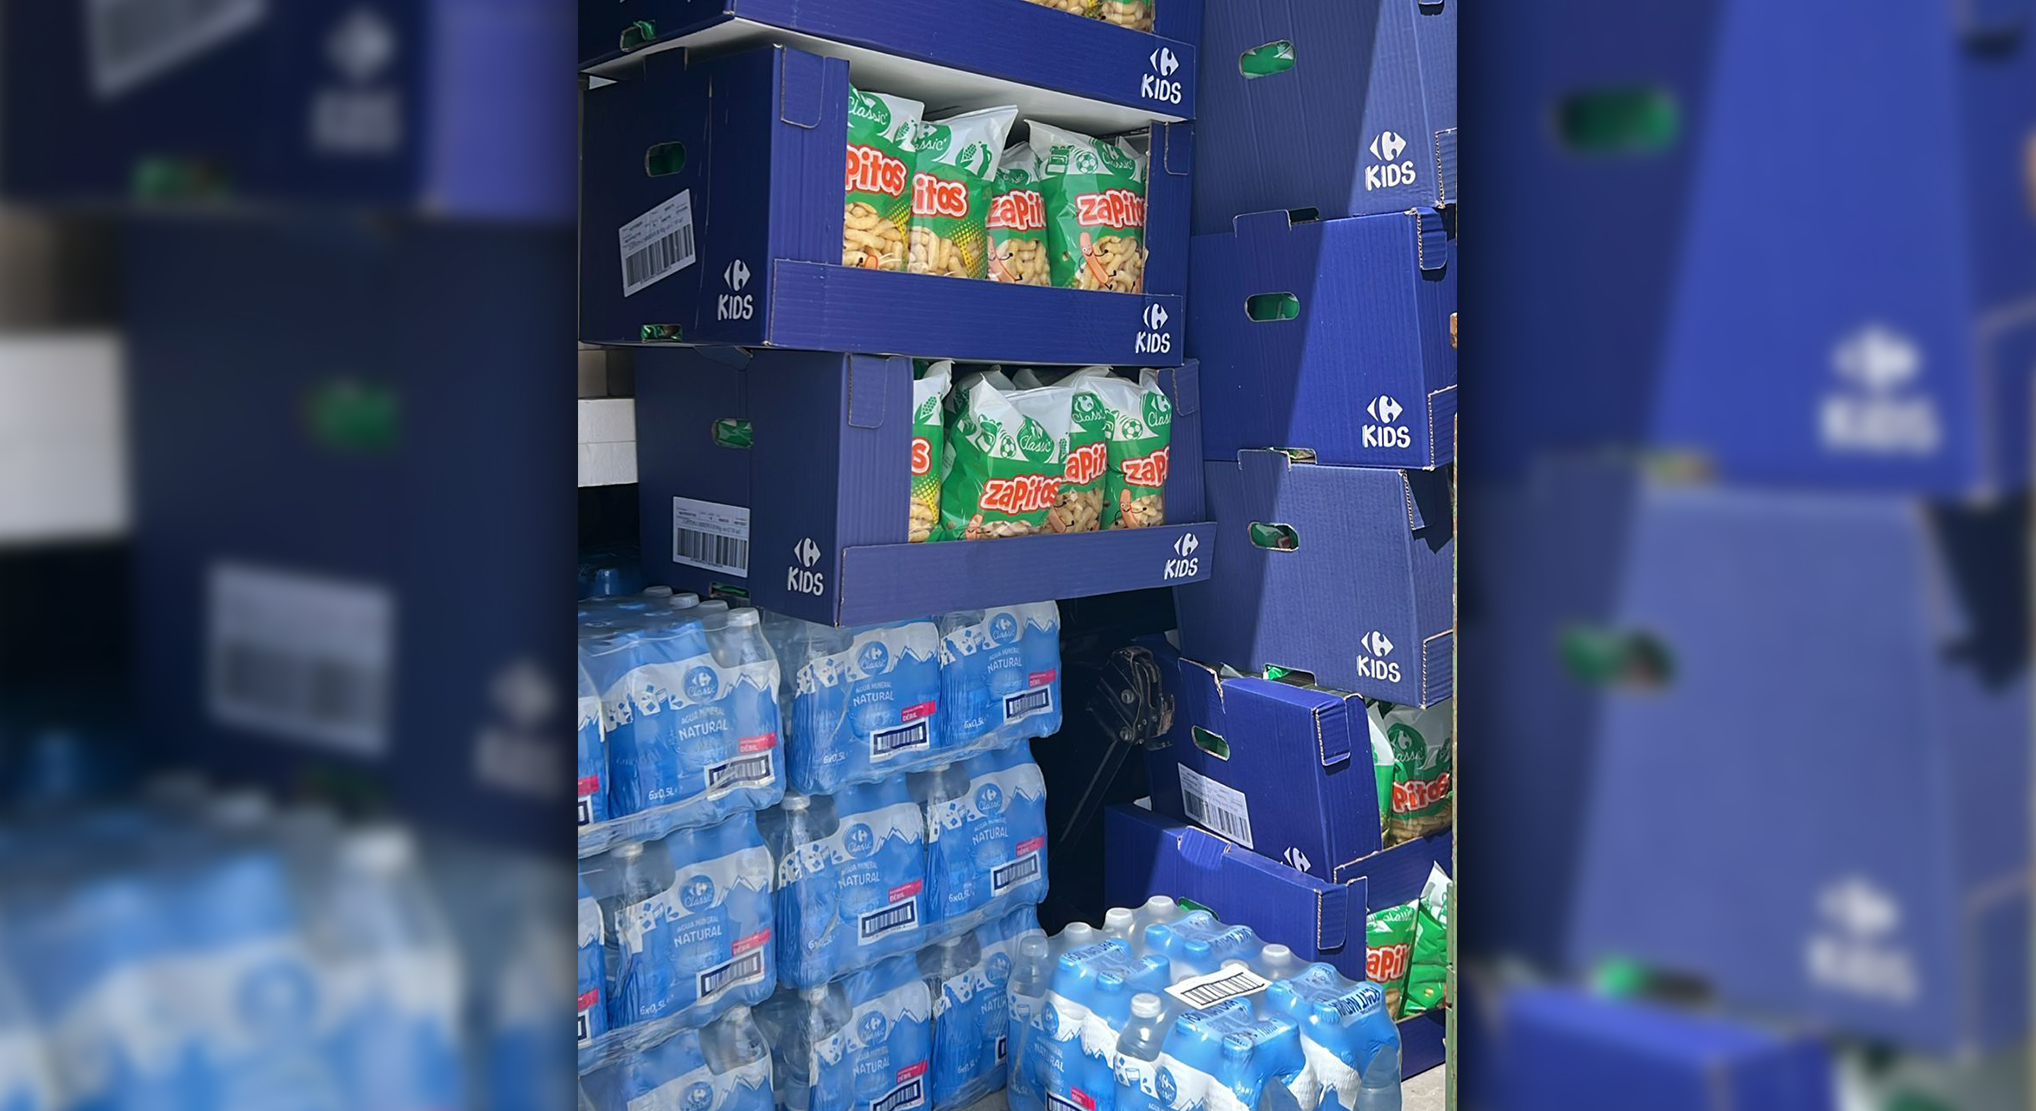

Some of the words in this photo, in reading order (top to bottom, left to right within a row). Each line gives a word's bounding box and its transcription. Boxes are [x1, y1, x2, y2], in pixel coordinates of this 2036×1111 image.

[1141, 74, 1182, 104] KIDS
[1365, 160, 1416, 191] KIDS
[717, 294, 754, 321] KIDS
[1135, 330, 1171, 353] KIDS
[1361, 424, 1411, 449] KIDS
[1164, 558, 1199, 580] KIDS
[787, 566, 824, 596] KIDS
[987, 657, 1022, 674] NATURAL
[1357, 655, 1401, 683] KIDS
[853, 691, 894, 707] NATURAL
[678, 719, 729, 741] NATURAL
[972, 826, 1008, 845] NATURAL
[838, 872, 880, 889] NATURAL
[674, 925, 722, 948] NATURAL
[853, 1057, 890, 1076] NATURAL
